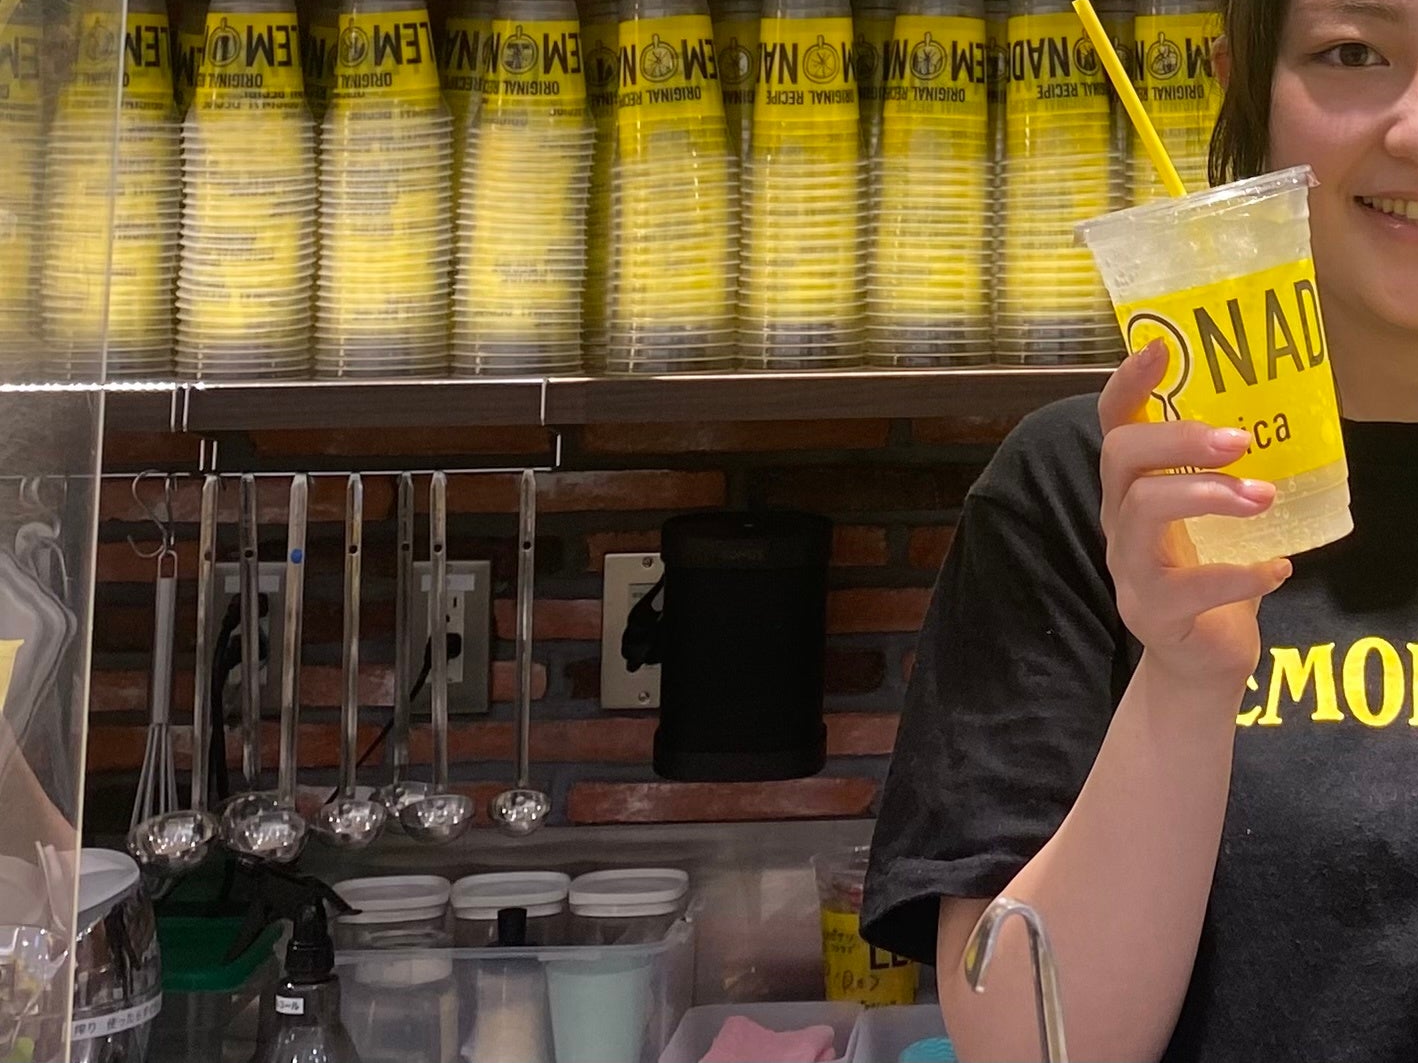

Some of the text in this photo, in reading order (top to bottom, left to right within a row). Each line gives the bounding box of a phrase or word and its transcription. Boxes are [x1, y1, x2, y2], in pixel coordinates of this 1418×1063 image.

[502, 80, 560, 95] ORIGINAL
[645, 86, 702, 104] ORIGINAL
[912, 86, 966, 102] ORIGINAL
[1036, 83, 1079, 99] RECIPE
[1151, 84, 1205, 101] ORIGINAL
[766, 90, 804, 105] RECIPE
